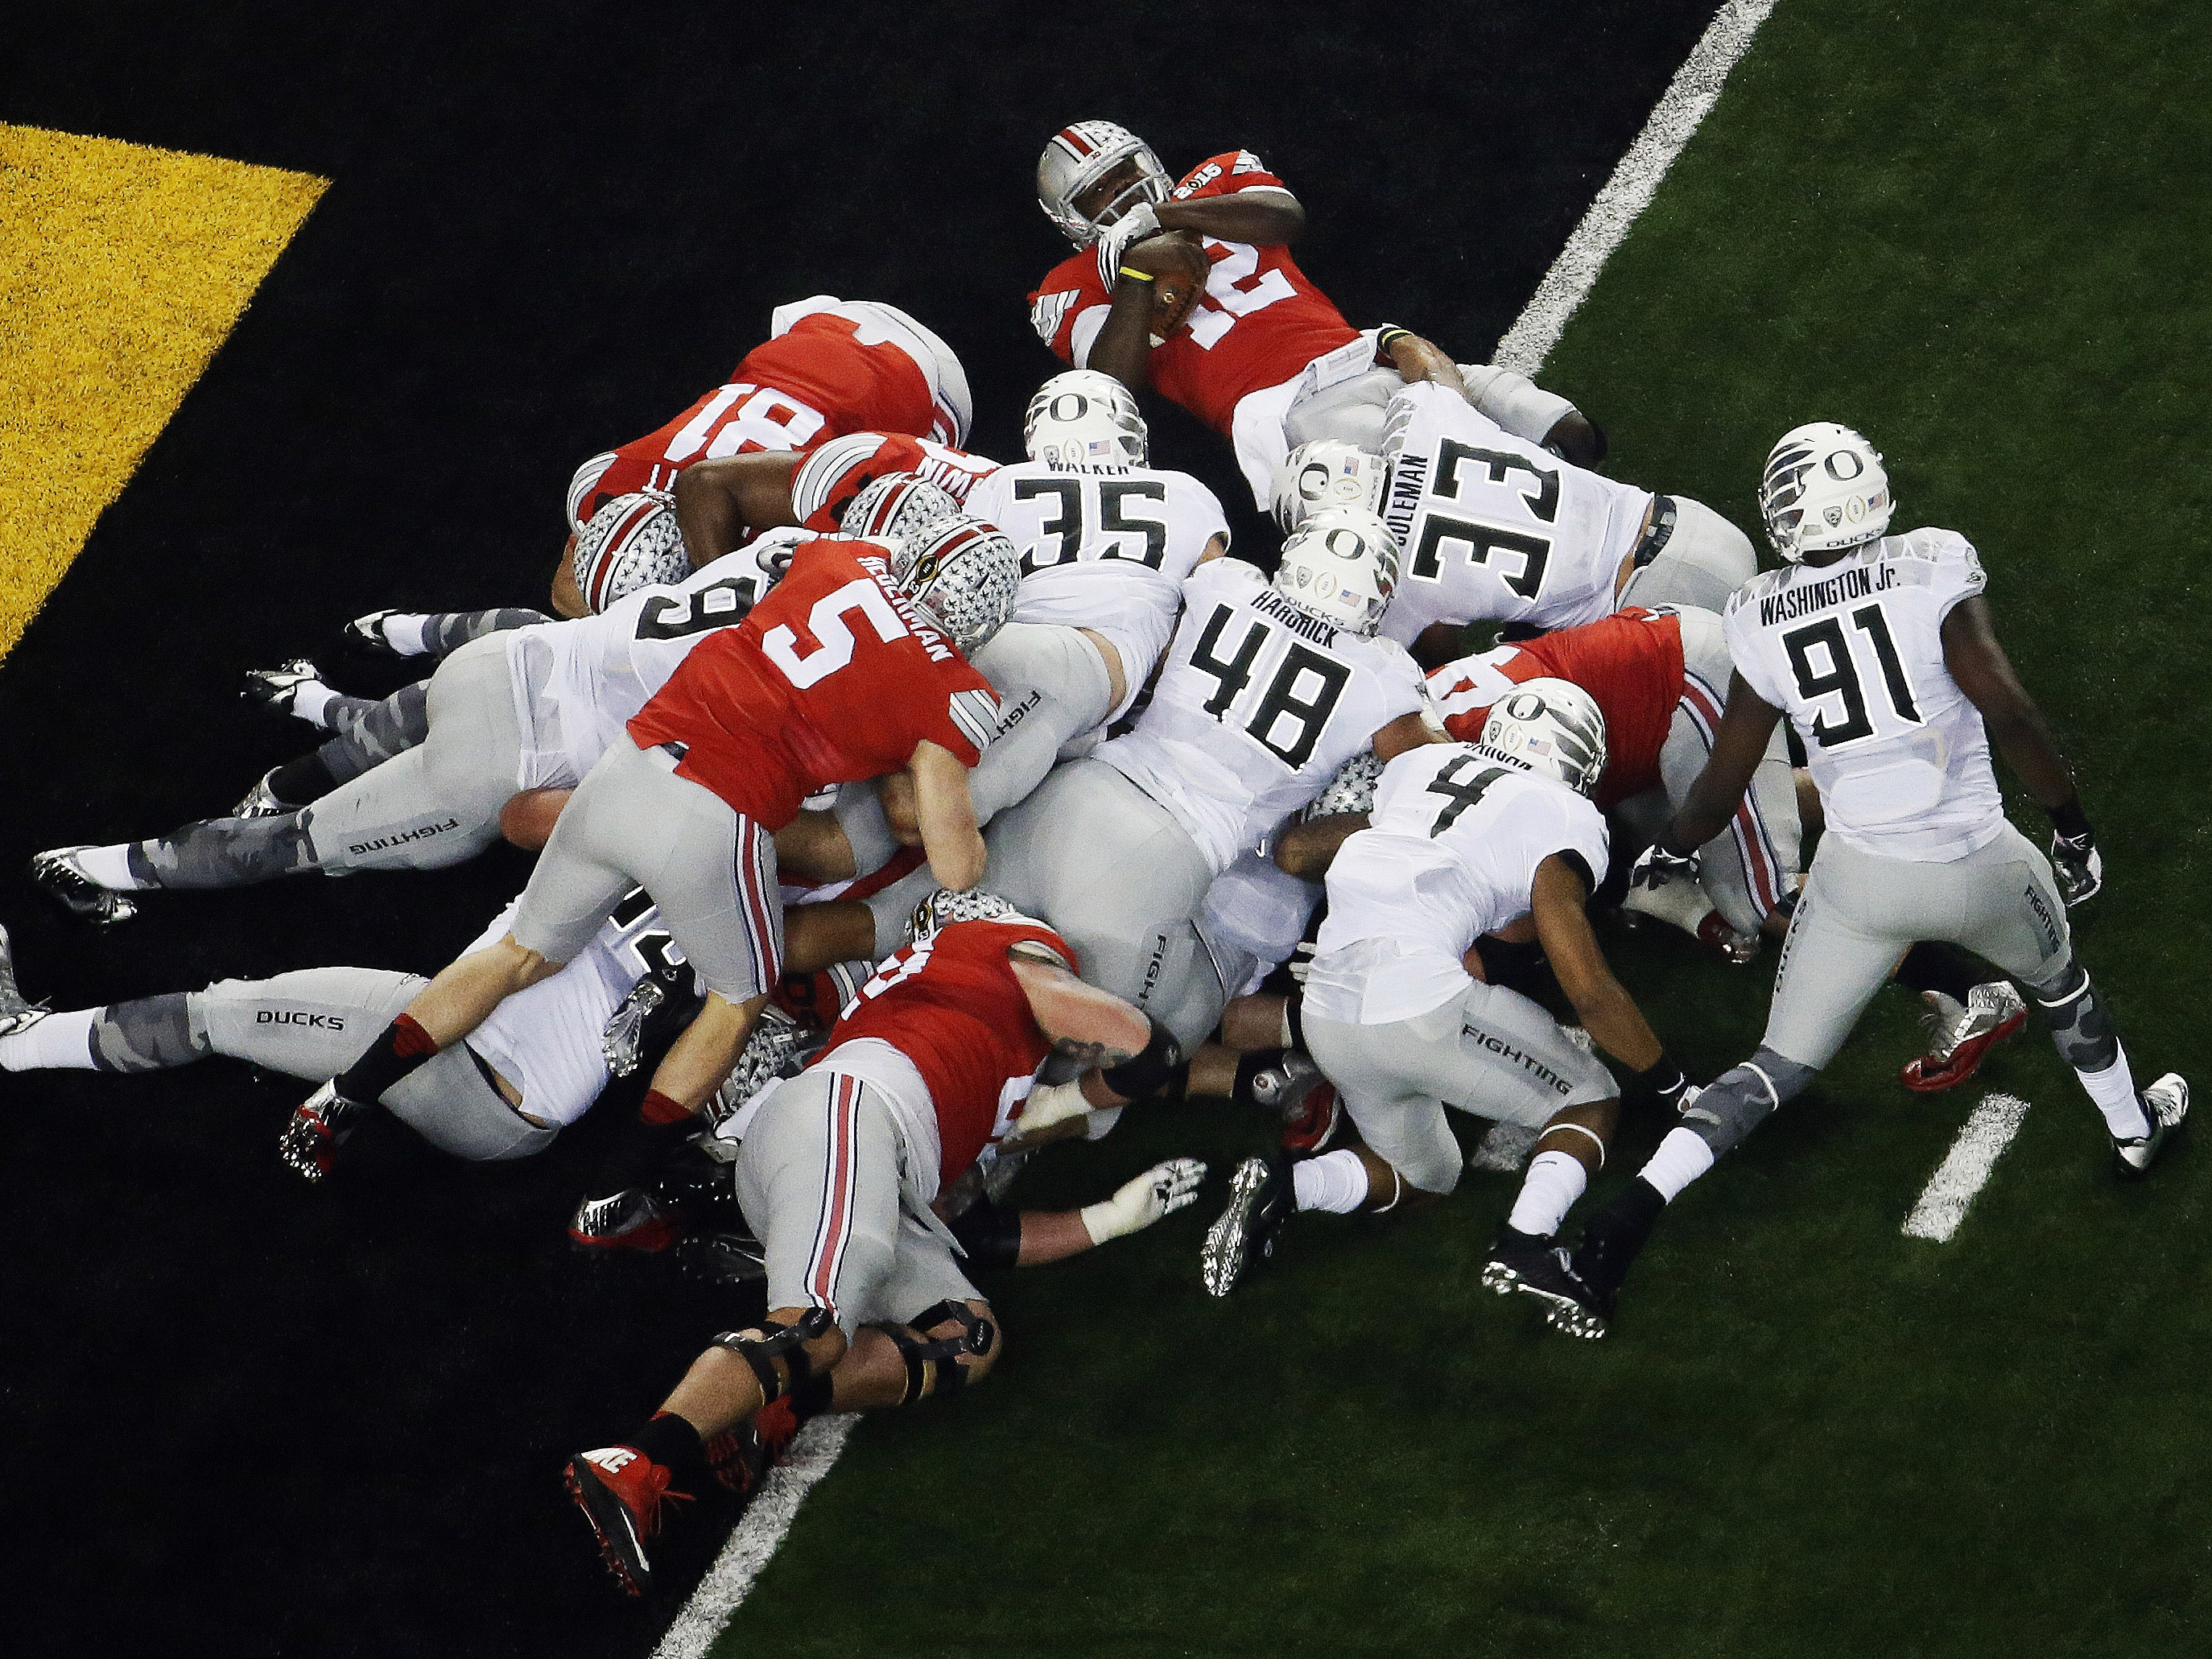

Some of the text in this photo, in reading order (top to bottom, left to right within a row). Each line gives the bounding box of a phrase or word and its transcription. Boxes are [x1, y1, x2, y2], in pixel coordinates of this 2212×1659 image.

[1049, 393, 1087, 422] O
[1824, 450, 1863, 481] O
[1013, 477, 1167, 577] 35
[1326, 528, 1366, 560] O
[1408, 435, 1563, 604] 33
[1760, 566, 1872, 627] WASHINGTON
[762, 577, 909, 689] 5
[1187, 600, 1355, 772] 48
[1506, 694, 1546, 720] O
[1777, 599, 1927, 750] 91
[1425, 753, 1518, 839] 4
[349, 817, 461, 856] FIGHTING
[256, 1009, 345, 1034] DUCKS
[1461, 1022, 1575, 1097] FIGHTING
